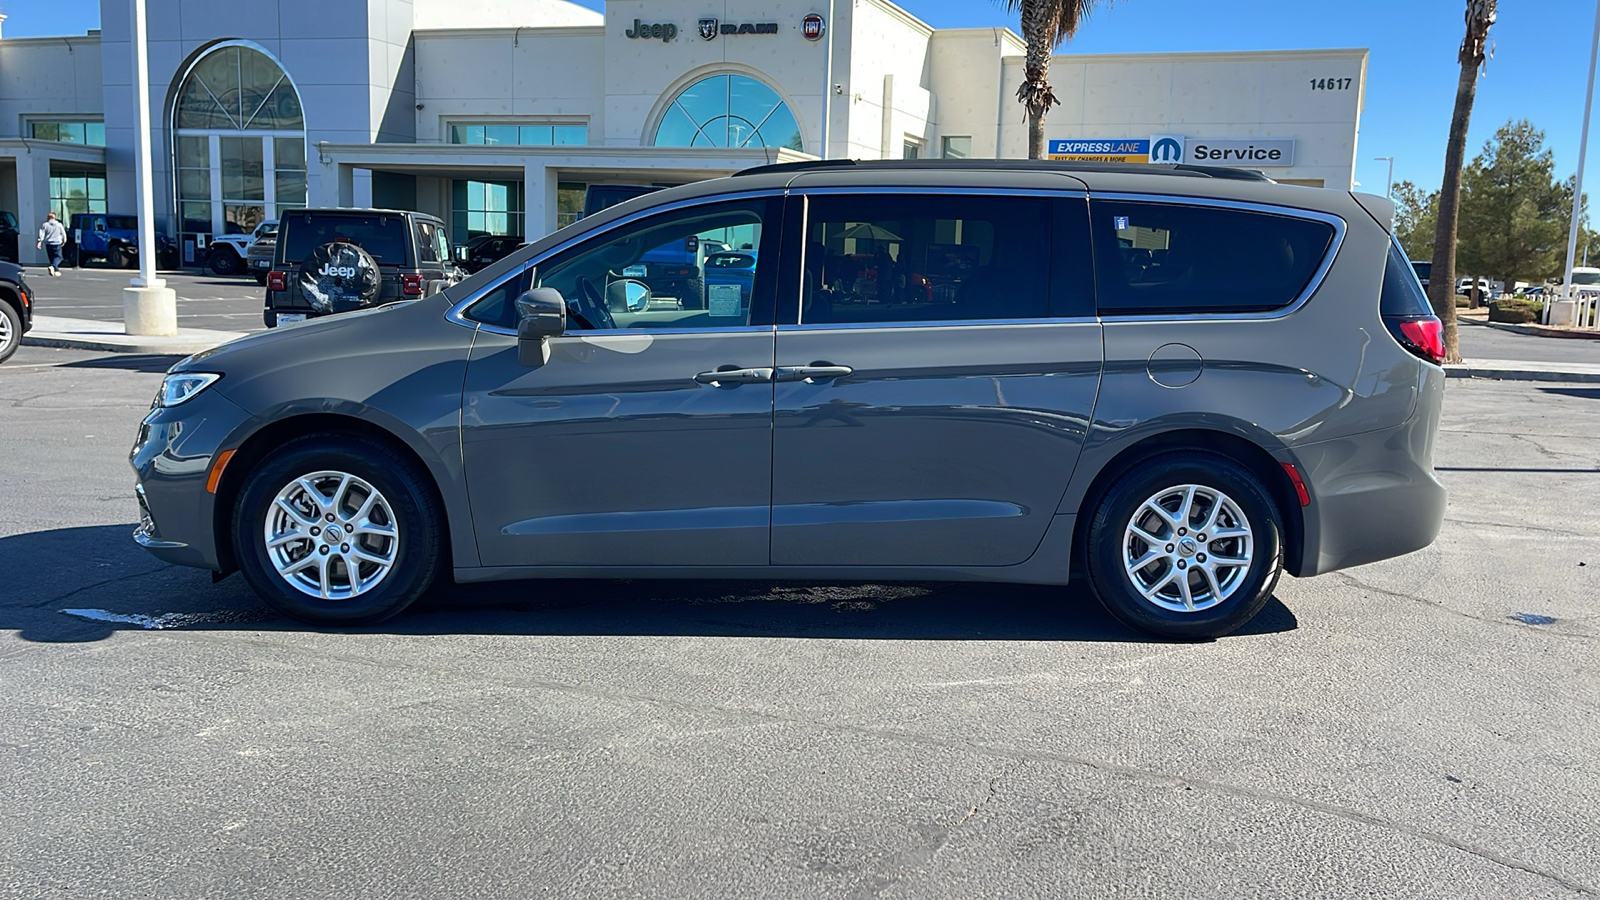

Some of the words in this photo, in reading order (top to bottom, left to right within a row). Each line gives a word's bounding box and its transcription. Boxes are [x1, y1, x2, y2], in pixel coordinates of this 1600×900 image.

[625, 18, 678, 43] Jeep
[720, 23, 778, 35] RAM
[805, 21, 820, 34] FIAT
[1310, 77, 1352, 90] 14617
[1194, 145, 1282, 161] Service
[318, 262, 356, 279] Jeep
